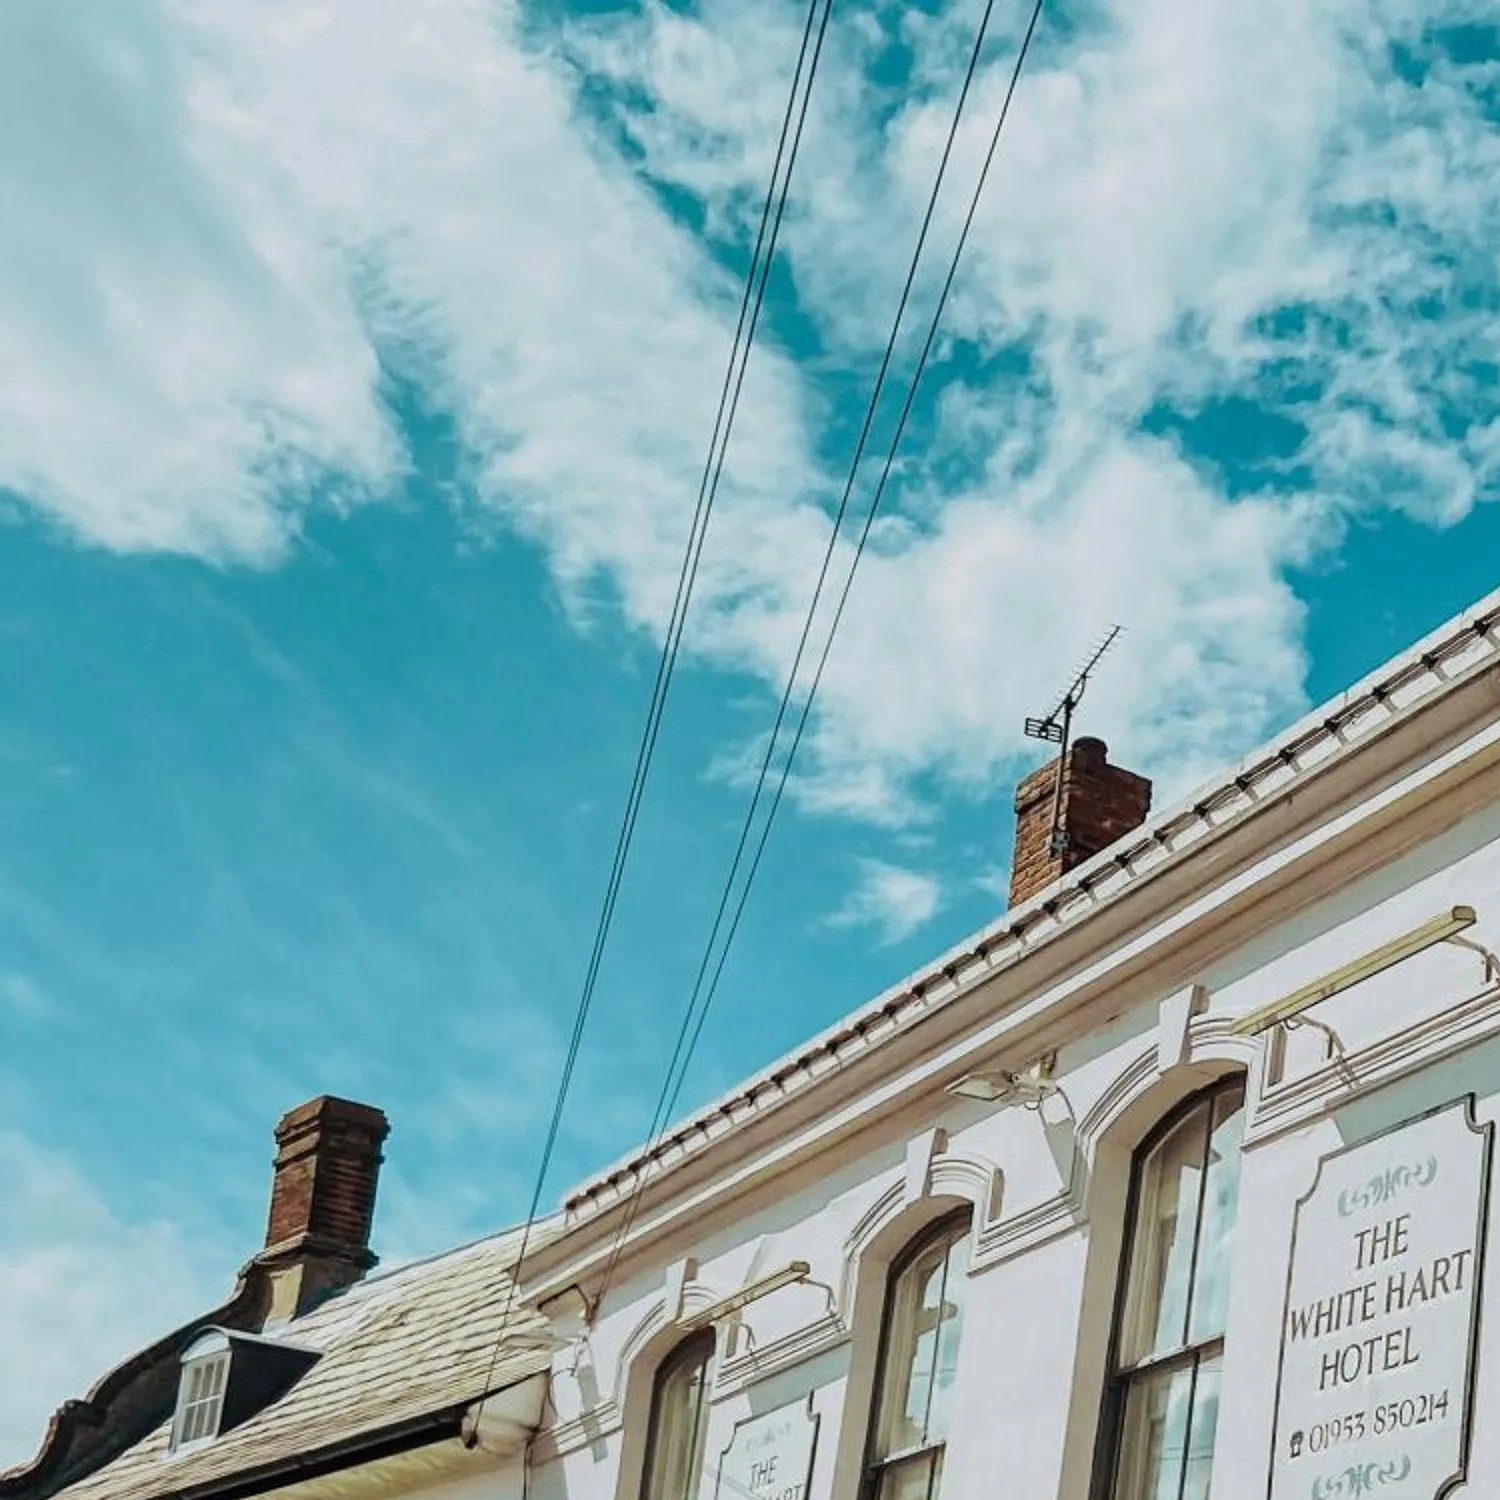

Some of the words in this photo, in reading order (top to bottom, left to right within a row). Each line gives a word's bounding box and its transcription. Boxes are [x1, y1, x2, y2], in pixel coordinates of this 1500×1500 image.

[1354, 1212, 1411, 1271] THE
[1291, 1281, 1377, 1344] WHITE
[1384, 1249, 1473, 1314] HART
[1319, 1326, 1420, 1391] HOTEL
[1309, 1411, 1366, 1453] 01953
[1373, 1389, 1449, 1435] 850214
[748, 1455, 779, 1494] THE
